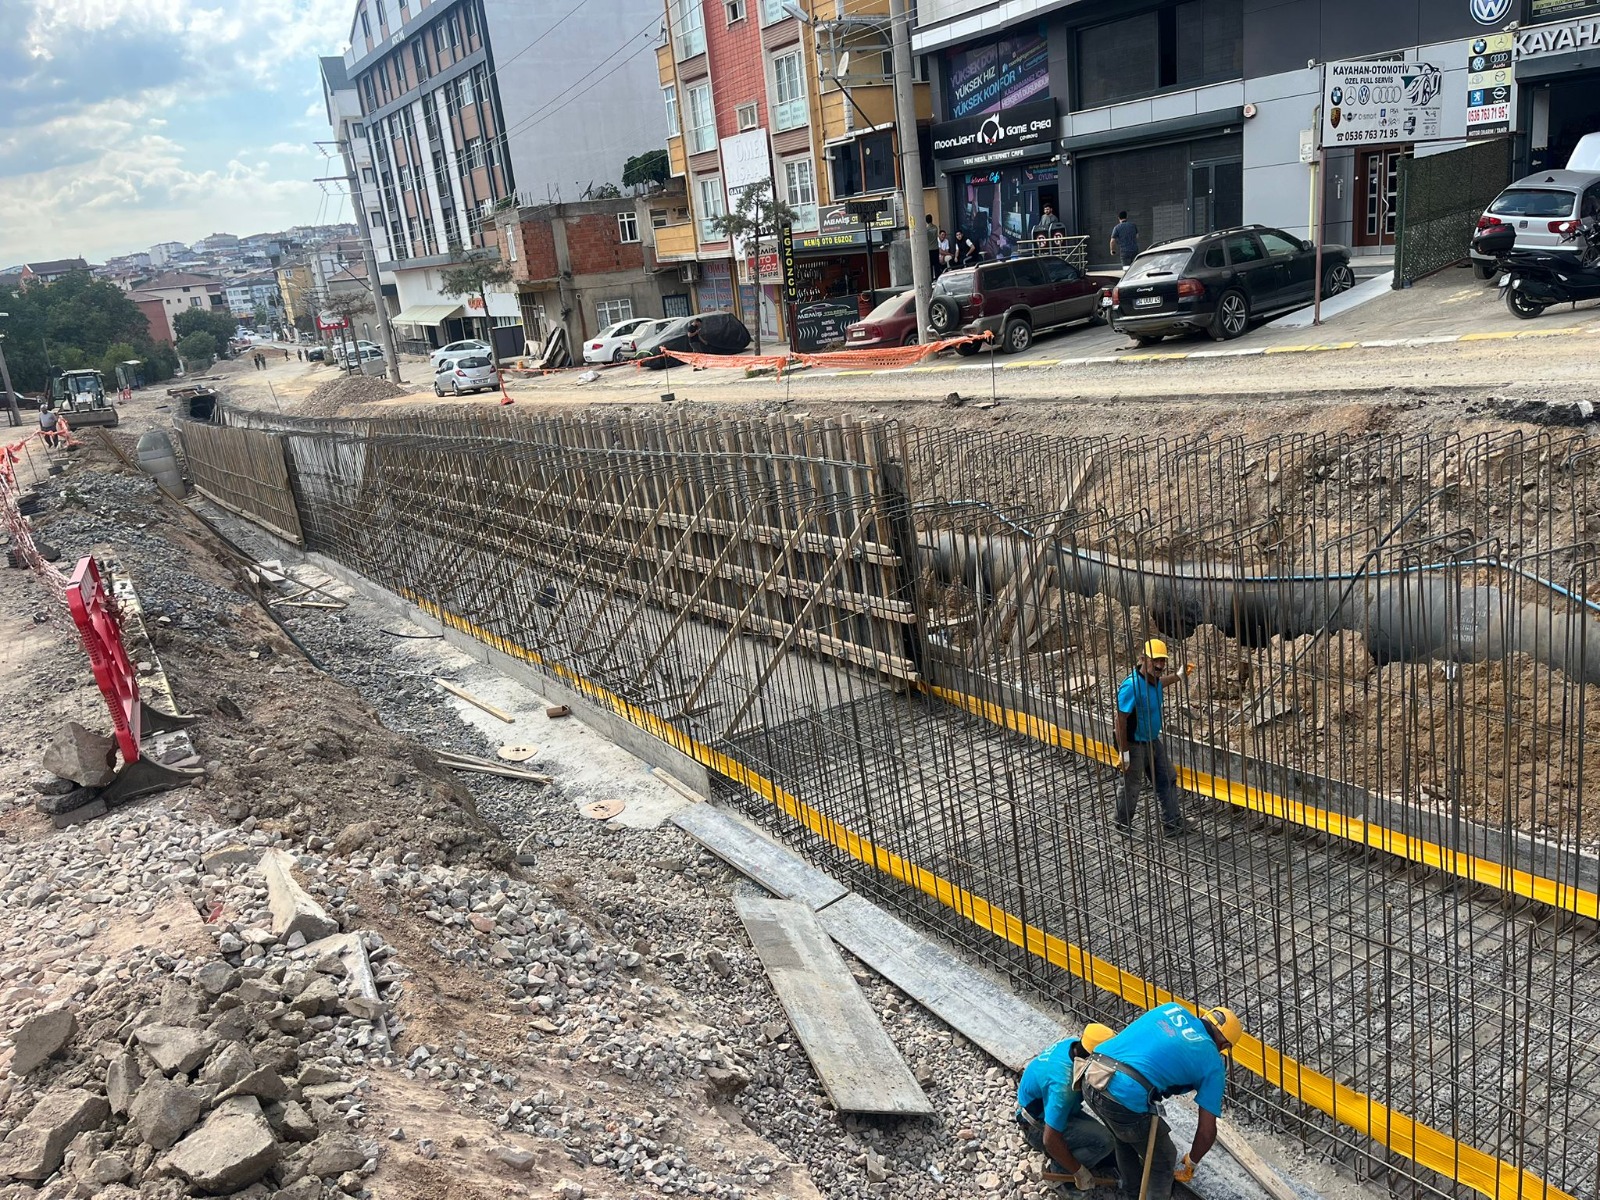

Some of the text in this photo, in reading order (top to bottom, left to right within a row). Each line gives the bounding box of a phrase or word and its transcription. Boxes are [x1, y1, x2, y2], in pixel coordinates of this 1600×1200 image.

[1333, 63, 1410, 76] KAYAHAN-OTOMOTİV
[955, 65, 996, 100] YÜKSEK HIZ
[1344, 76, 1359, 85] ÖZEL
[1374, 76, 1394, 84] SERVİS
[953, 70, 1016, 118] YÜKSEK KONFOR
[1468, 109, 1480, 122] 0536
[1480, 107, 1490, 121] 763
[1490, 107, 1497, 119] 71
[1498, 106, 1505, 118] 95
[1344, 128, 1399, 141] 0536 763 71 95
[1011, 149, 1024, 157] CAFE
[803, 235, 853, 247] MEMİŞ OTO EGZOZ
[747, 246, 778, 257] MMİŞ
[783, 227, 796, 296] EGZOZCU
[749, 263, 778, 274] EZOZ
